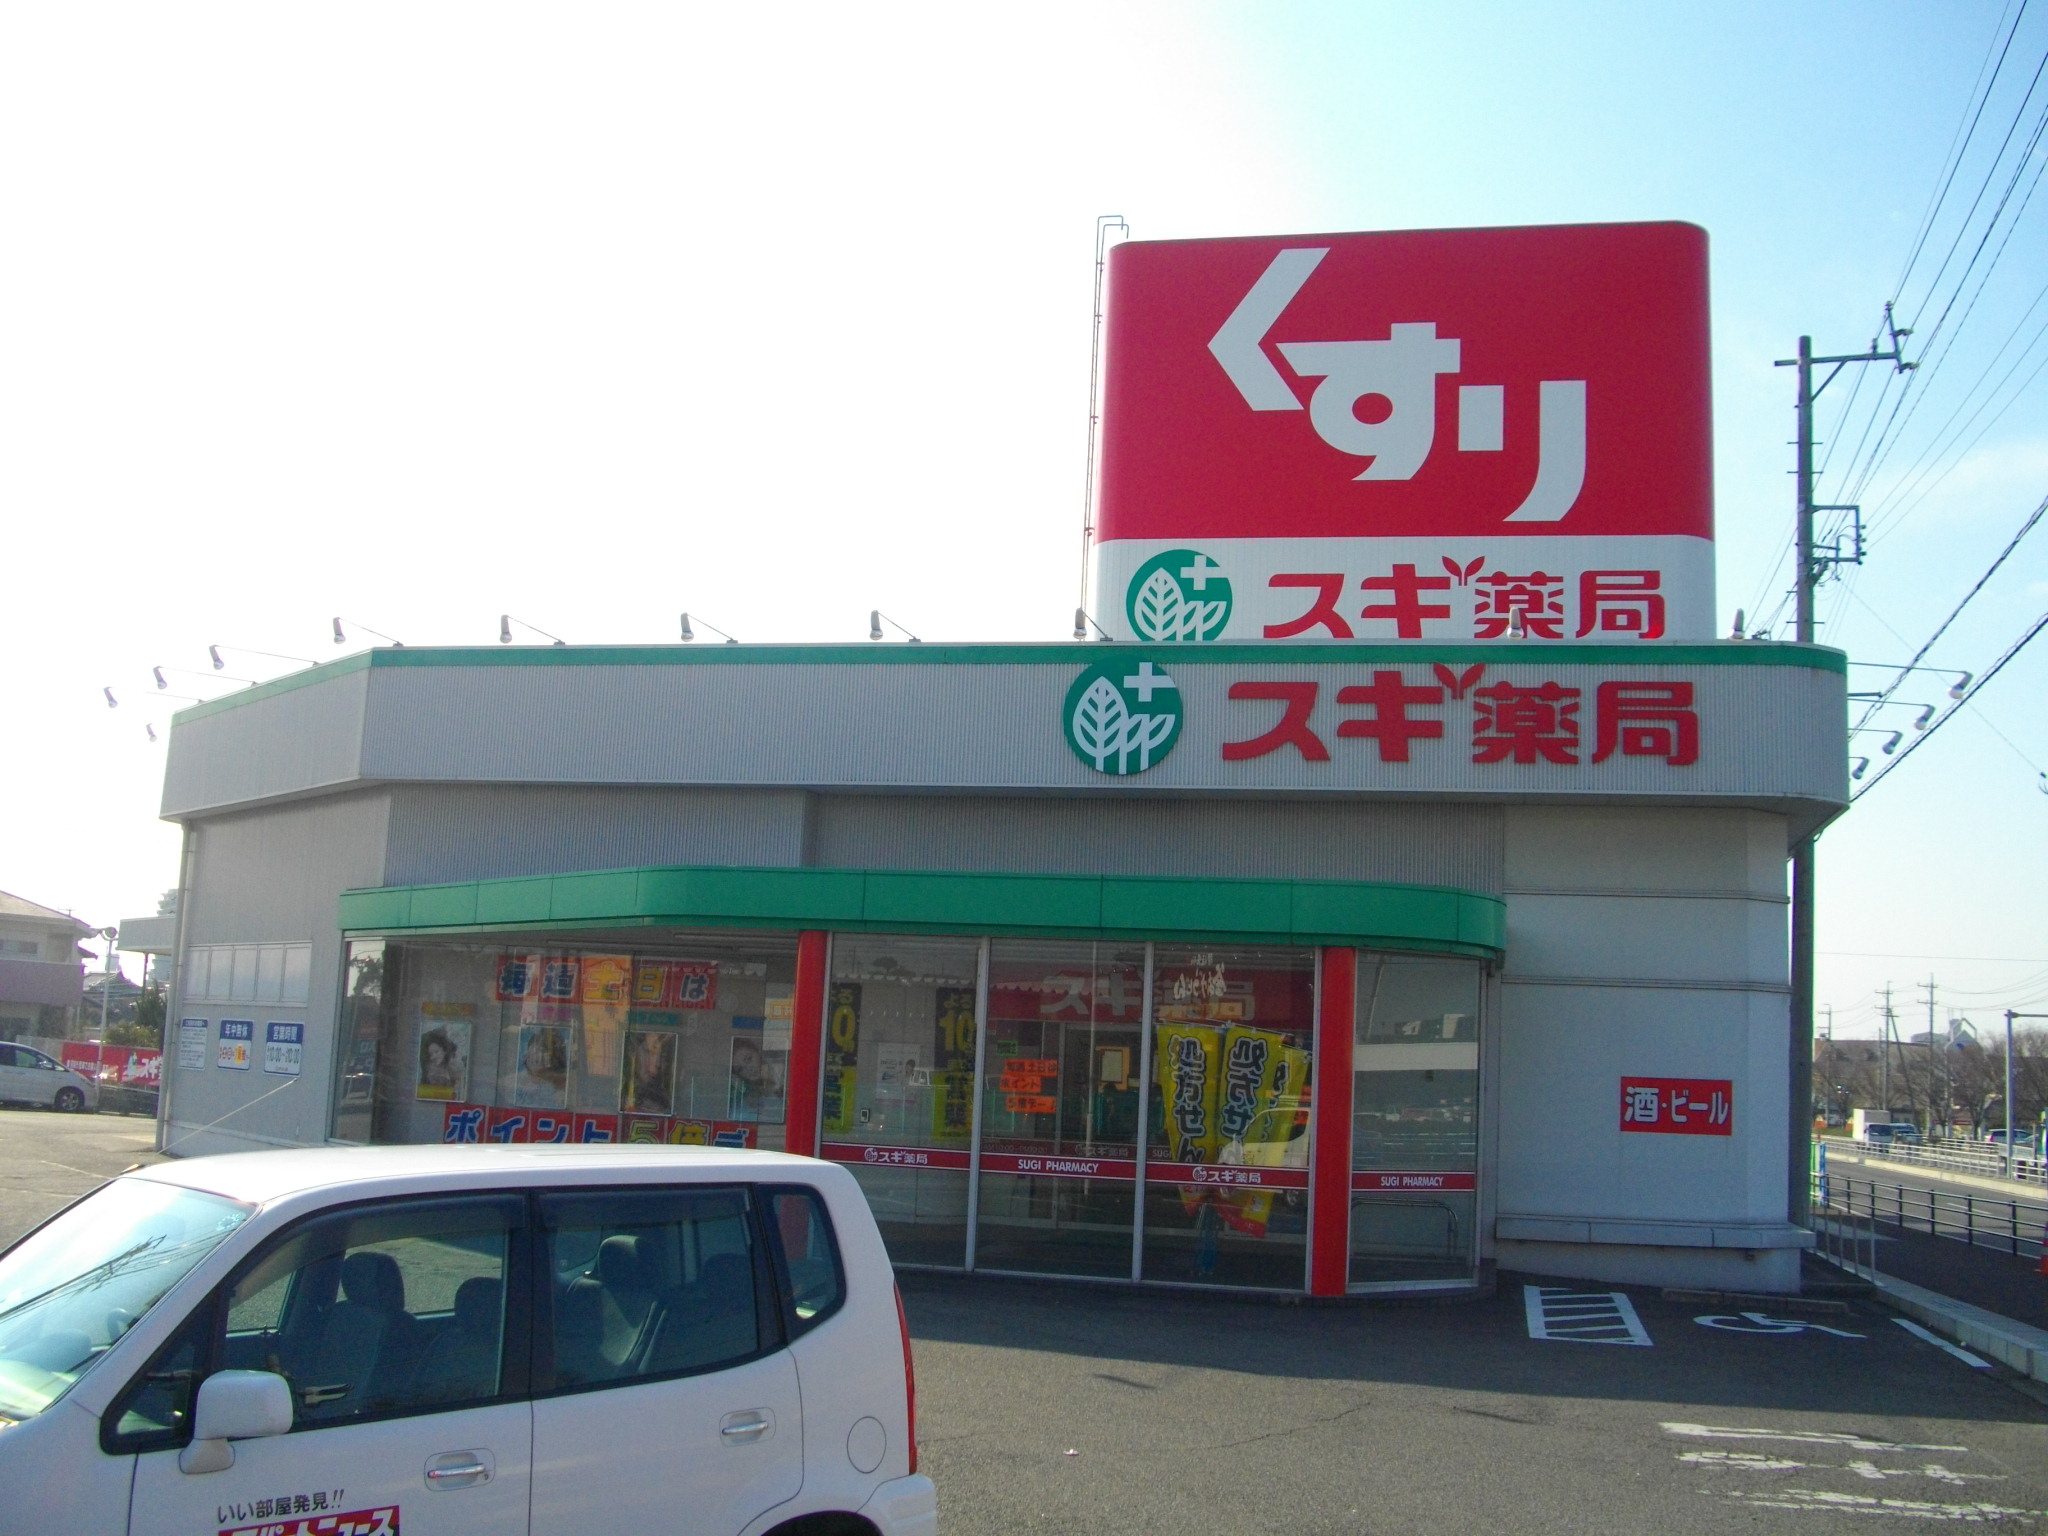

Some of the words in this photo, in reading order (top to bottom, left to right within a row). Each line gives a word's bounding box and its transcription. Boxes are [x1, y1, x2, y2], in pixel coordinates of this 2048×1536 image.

[1207, 247, 1587, 522] くすり
[1263, 555, 1665, 640] スギ薬局
[1222, 662, 1699, 766] スギ薬局
[225, 1023, 249, 1038] 年中無休
[273, 1025, 298, 1041] 営業時間
[878, 1149, 928, 1165] スギ薬局
[1018, 1158, 1041, 1171] SUGI
[1045, 1160, 1099, 1174] PHARMACY
[1207, 1169, 1262, 1184] スギ薬局
[1380, 1176, 1399, 1187] SUGI
[1402, 1176, 1444, 1188] PHARMACY
[217, 1489, 344, 1523] いい部屋発見!!
